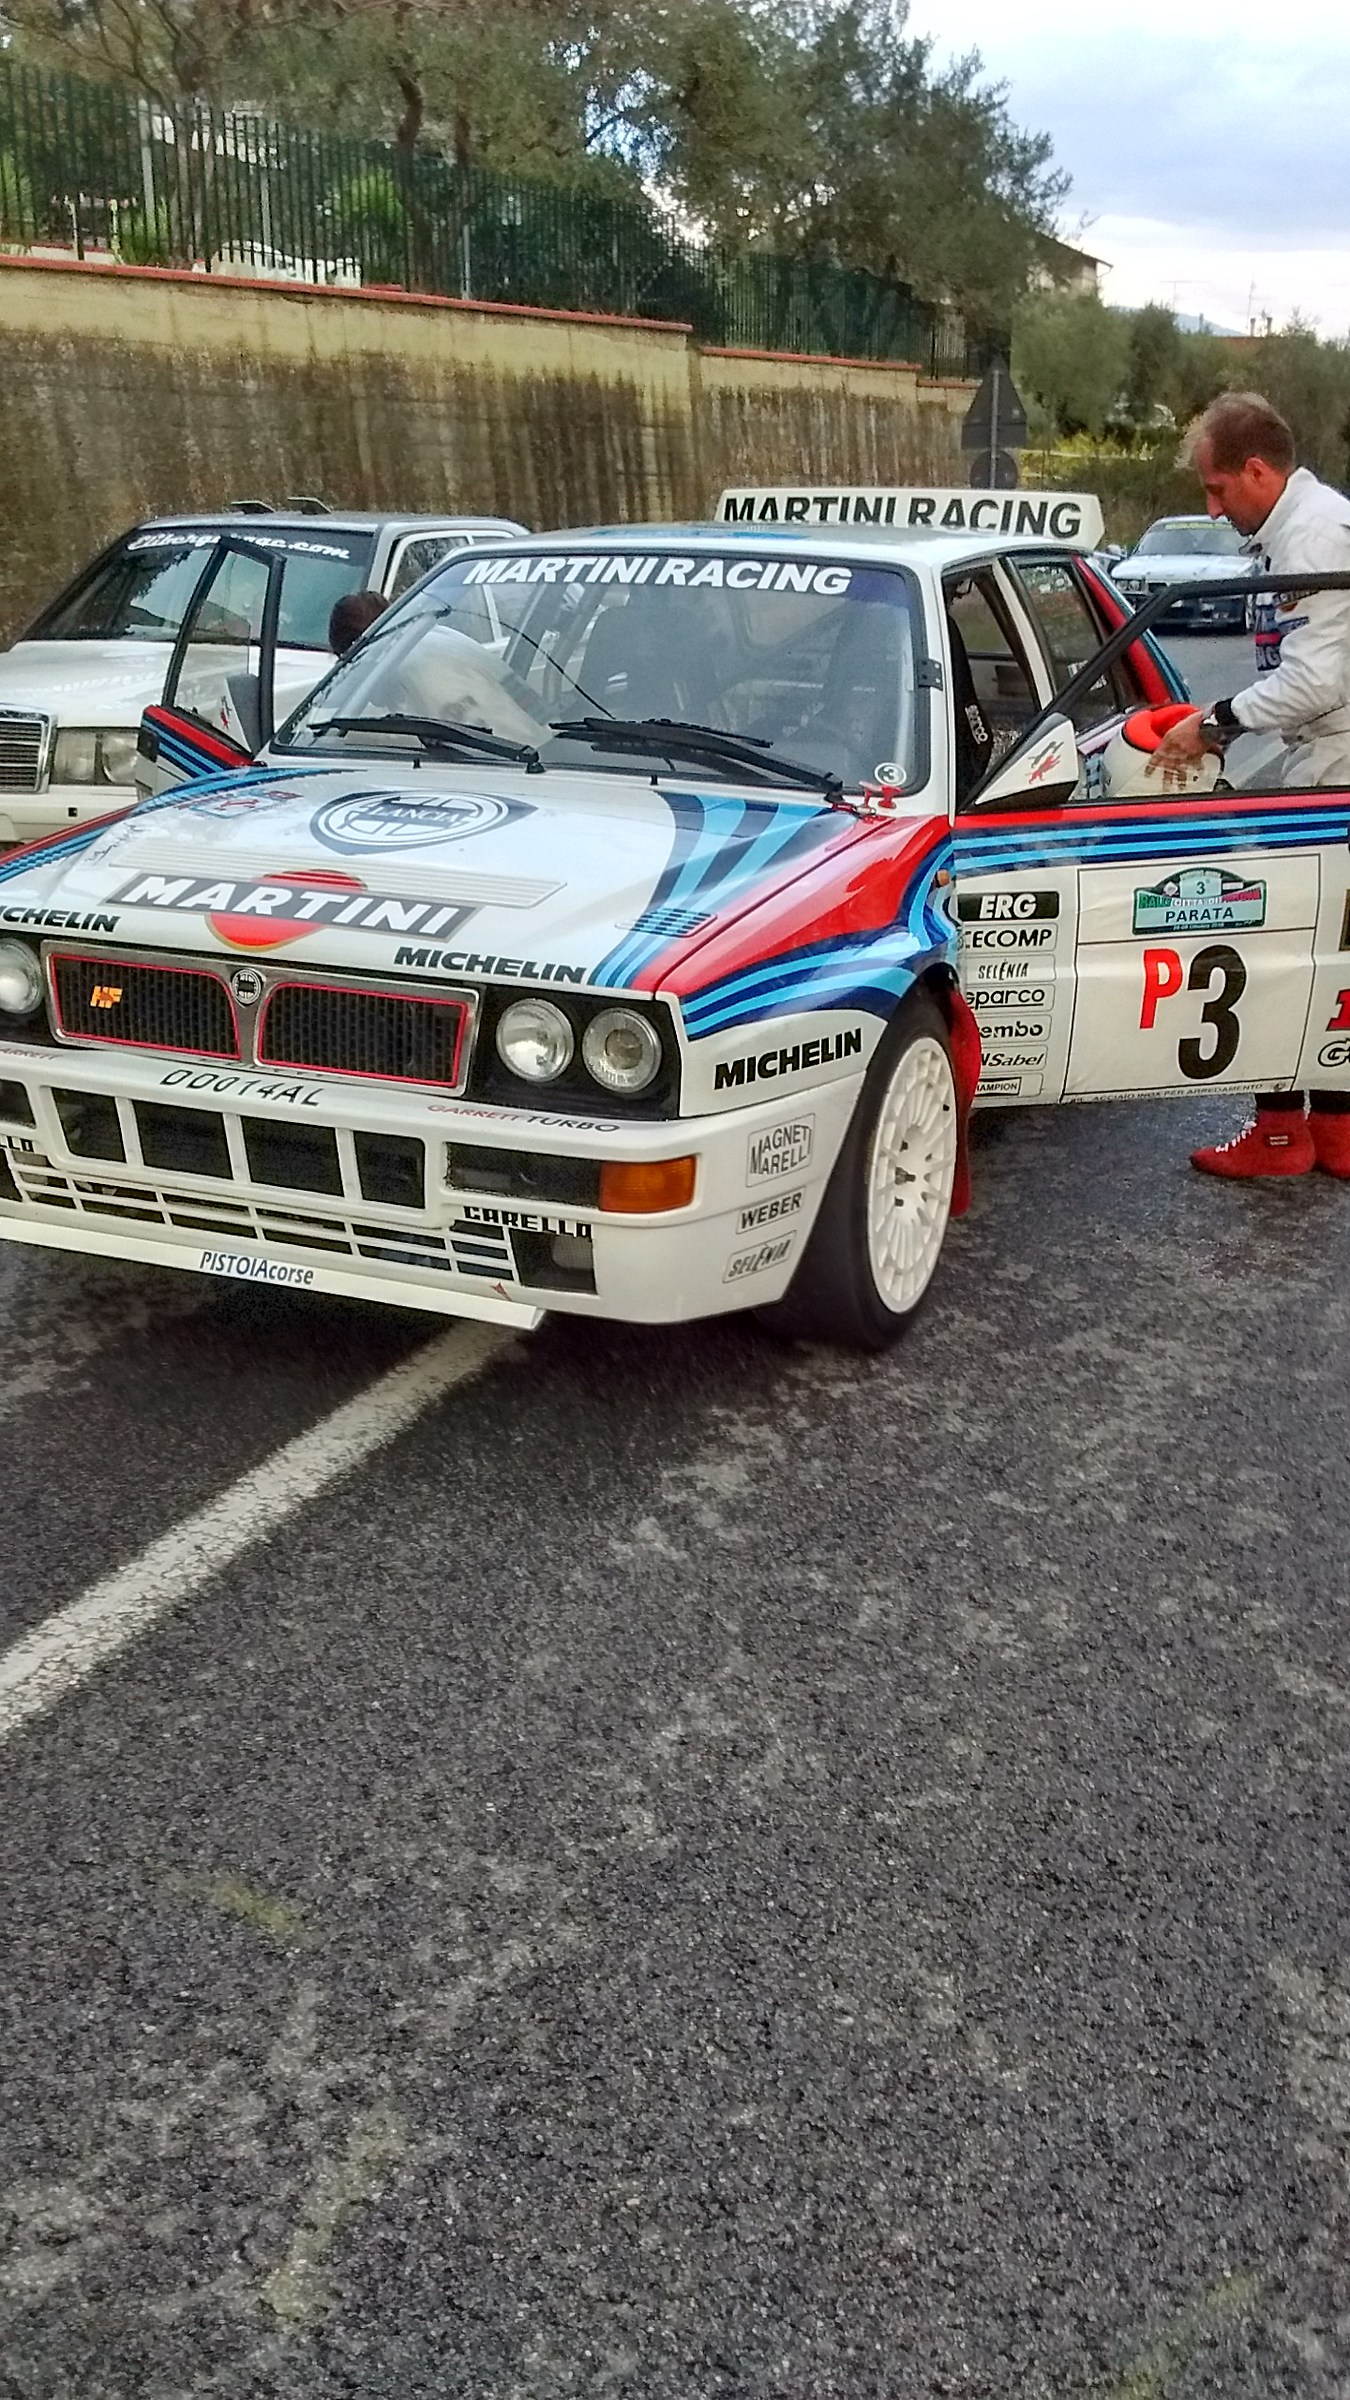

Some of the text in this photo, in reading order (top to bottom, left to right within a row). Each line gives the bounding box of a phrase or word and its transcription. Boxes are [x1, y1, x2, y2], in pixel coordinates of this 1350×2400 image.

[724, 496, 1082, 538] MARTINI RACING
[462, 556, 853, 594] MARTINI RACING
[369, 805, 463, 824] LANCIA
[121, 876, 459, 934] MARTINI
[979, 893, 1037, 919] ERG
[1165, 907, 1234, 923] PARATA
[393, 945, 587, 984] MICHELIN
[980, 1021, 1044, 1038] embo
[714, 1028, 862, 1090] MICHELIN
[1186, 1083, 1263, 1096] ARREDAMENTO
[427, 1104, 621, 1133] GARRETT TURBO
[463, 1205, 593, 1239] CARELLO
[741, 1192, 802, 1230] WEBER
[200, 1251, 314, 1285] PISTOIAcorse
